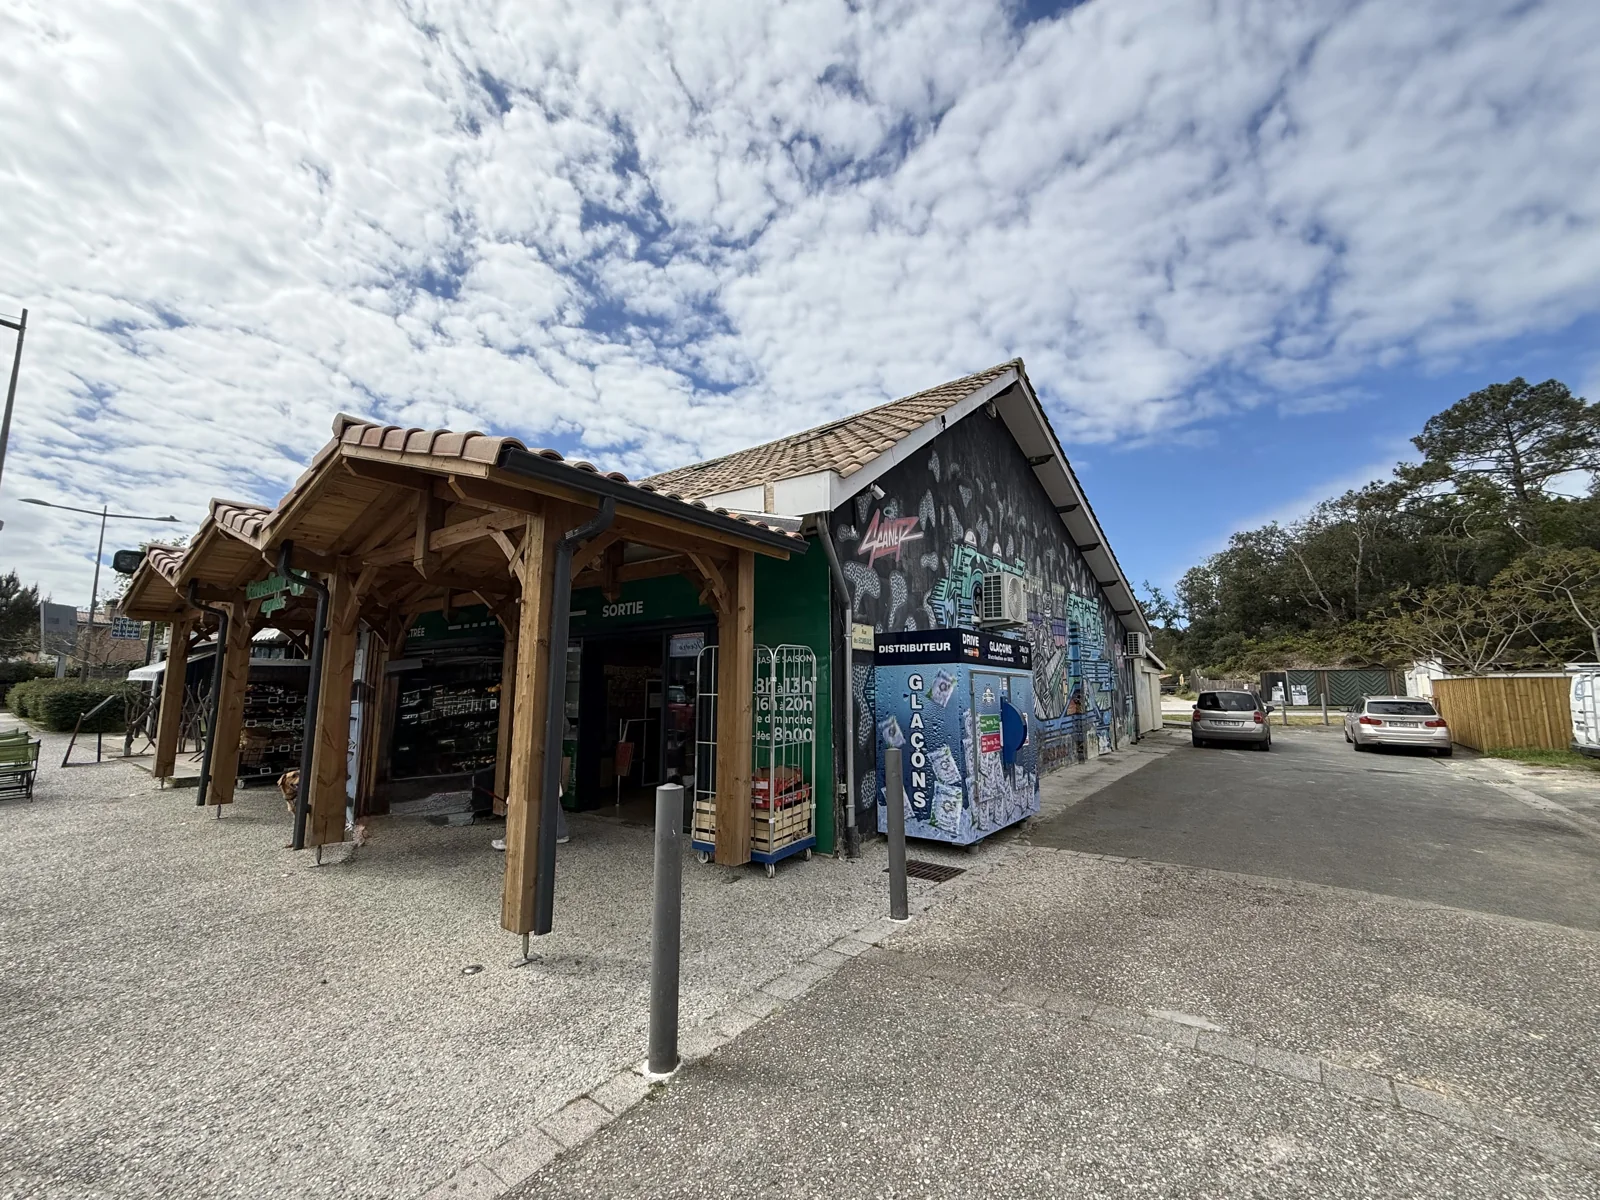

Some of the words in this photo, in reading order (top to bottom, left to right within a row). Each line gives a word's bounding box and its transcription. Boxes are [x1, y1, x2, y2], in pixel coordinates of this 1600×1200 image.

[602, 601, 644, 617] SORTIE
[408, 625, 425, 637] TRÉE
[962, 633, 980, 647] DRIVE
[879, 642, 951, 653] DISTRIBUTEUR
[989, 641, 1013, 655] GLAÇONS
[782, 655, 813, 663] SAISON
[785, 677, 813, 693] 13h
[786, 697, 813, 711] 20h
[774, 727, 812, 742] 8h00
[908, 674, 927, 809] GLAÇONS
